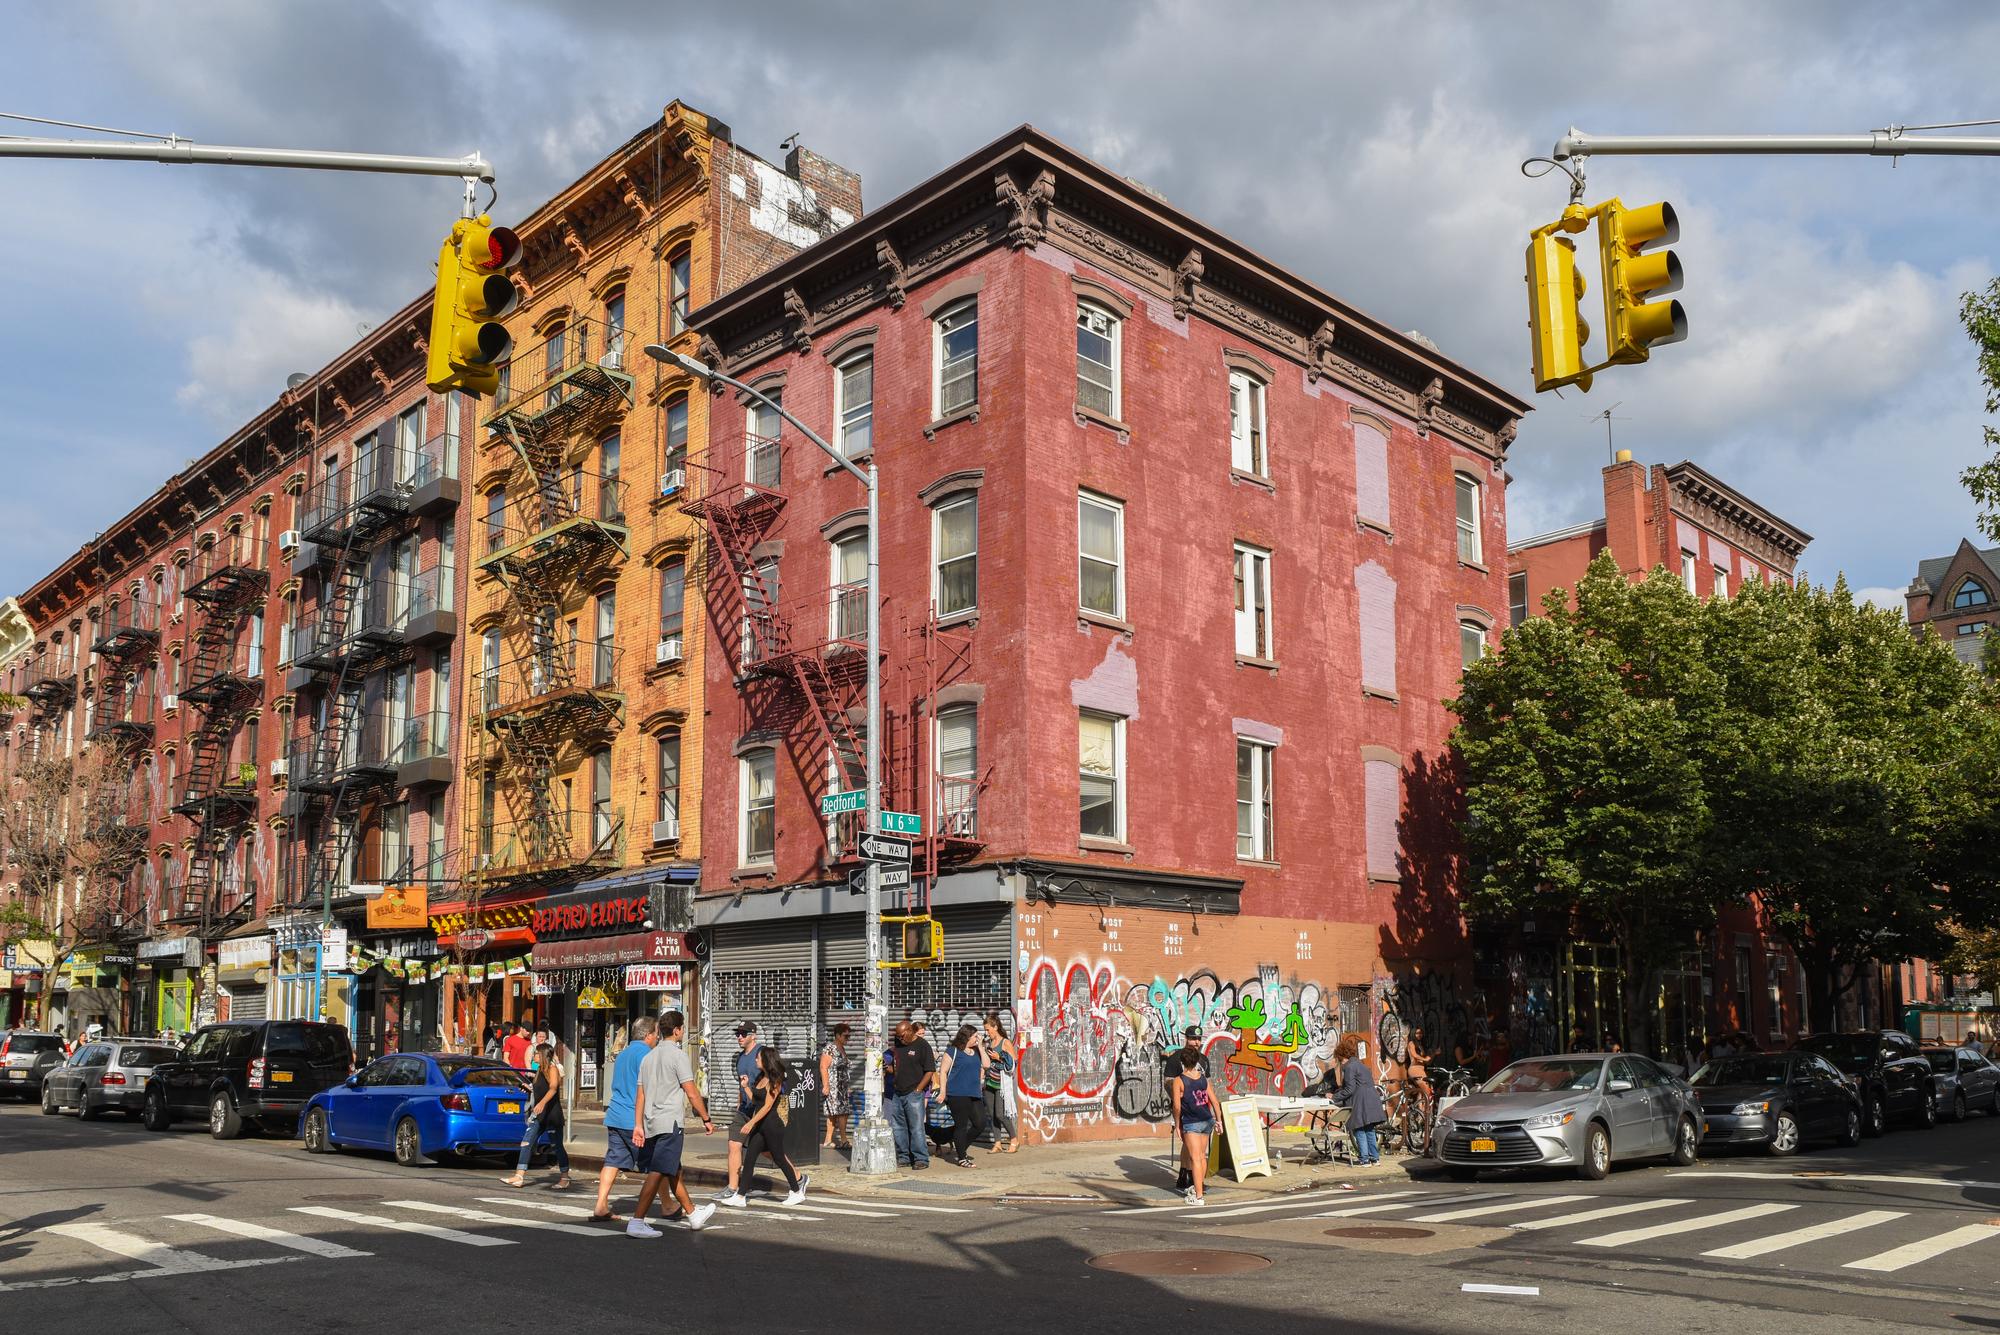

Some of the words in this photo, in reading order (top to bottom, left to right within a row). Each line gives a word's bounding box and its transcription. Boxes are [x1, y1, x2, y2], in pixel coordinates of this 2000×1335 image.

[823, 793, 857, 813] Bedford
[886, 814, 893, 829] N
[898, 816, 904, 830] 6
[866, 841, 881, 853] ONE
[888, 844, 905, 856] WAY
[884, 872, 903, 884] WAY
[533, 902, 587, 933] BEDFORD
[591, 896, 647, 927] EXOTICS
[1019, 913, 1042, 924] POST
[1103, 918, 1123, 927] POST
[1168, 923, 1178, 932] NO
[1026, 928, 1036, 936] NO
[1108, 931, 1118, 940] NO
[1300, 932, 1307, 940] NO
[655, 936, 663, 945] 24
[666, 936, 679, 945] Hrs
[1019, 940, 1041, 950] BILL
[1164, 935, 1183, 945] POST
[654, 945, 680, 956] ATM
[1103, 942, 1123, 952] BILL
[1164, 946, 1183, 955] BILL
[1296, 942, 1312, 951] POST
[618, 949, 643, 961] Magazine
[1296, 952, 1312, 960] BILL
[627, 970, 647, 986] ATM
[649, 970, 680, 986] ATM
